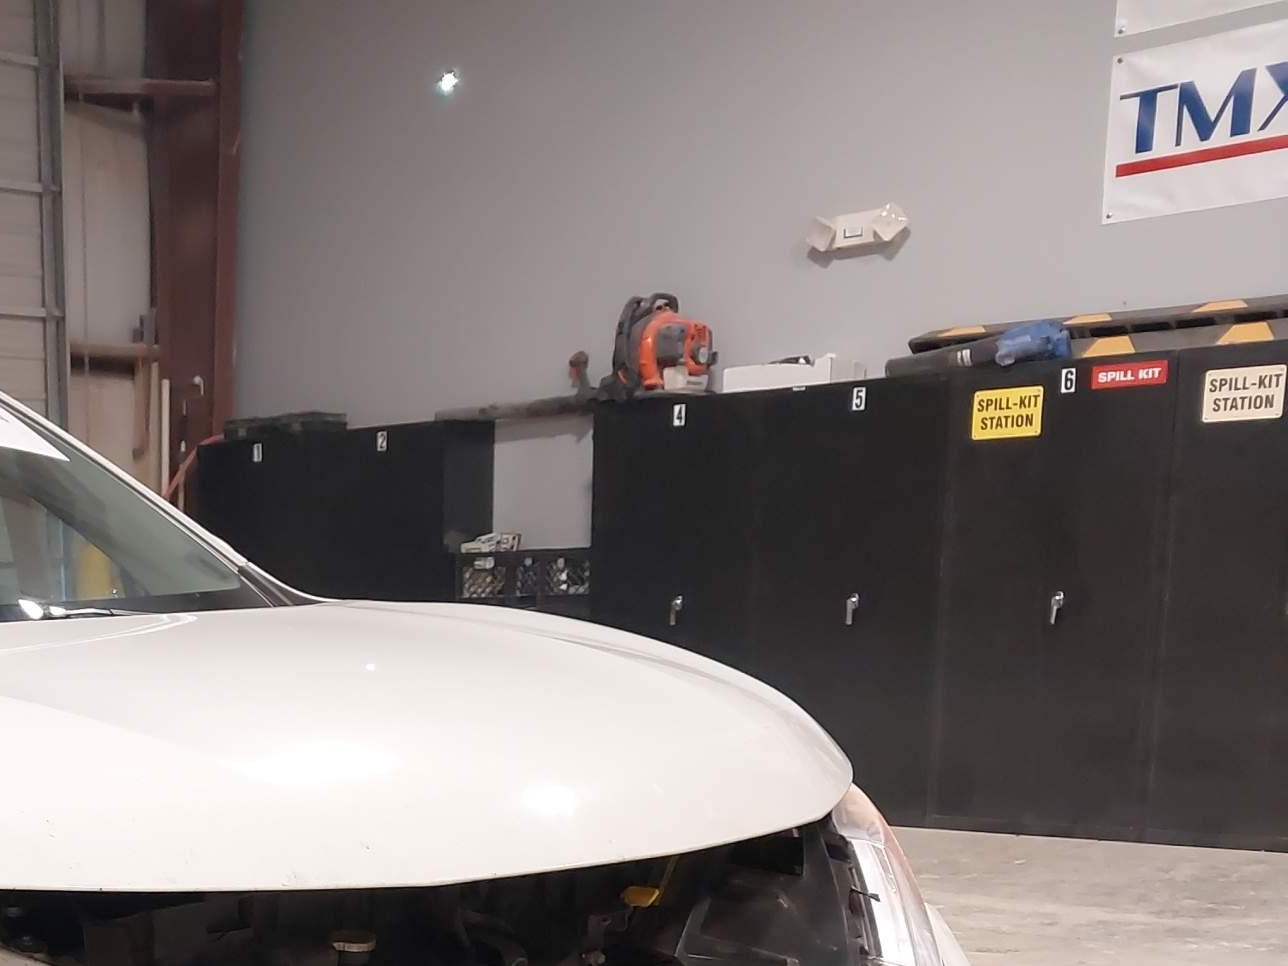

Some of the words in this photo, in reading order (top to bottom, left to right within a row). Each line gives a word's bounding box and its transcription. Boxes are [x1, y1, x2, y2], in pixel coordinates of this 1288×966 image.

[1064, 369, 1074, 391] 6
[1097, 369, 1135, 384] SPILL
[1138, 367, 1162, 381] KIT
[1209, 373, 1283, 393] SPILL-KIT
[855, 388, 864, 409] 5
[977, 394, 1041, 413] SPILL-KIT
[1212, 394, 1275, 412] STATION
[980, 413, 1034, 431] STATION
[377, 432, 387, 450] 2
